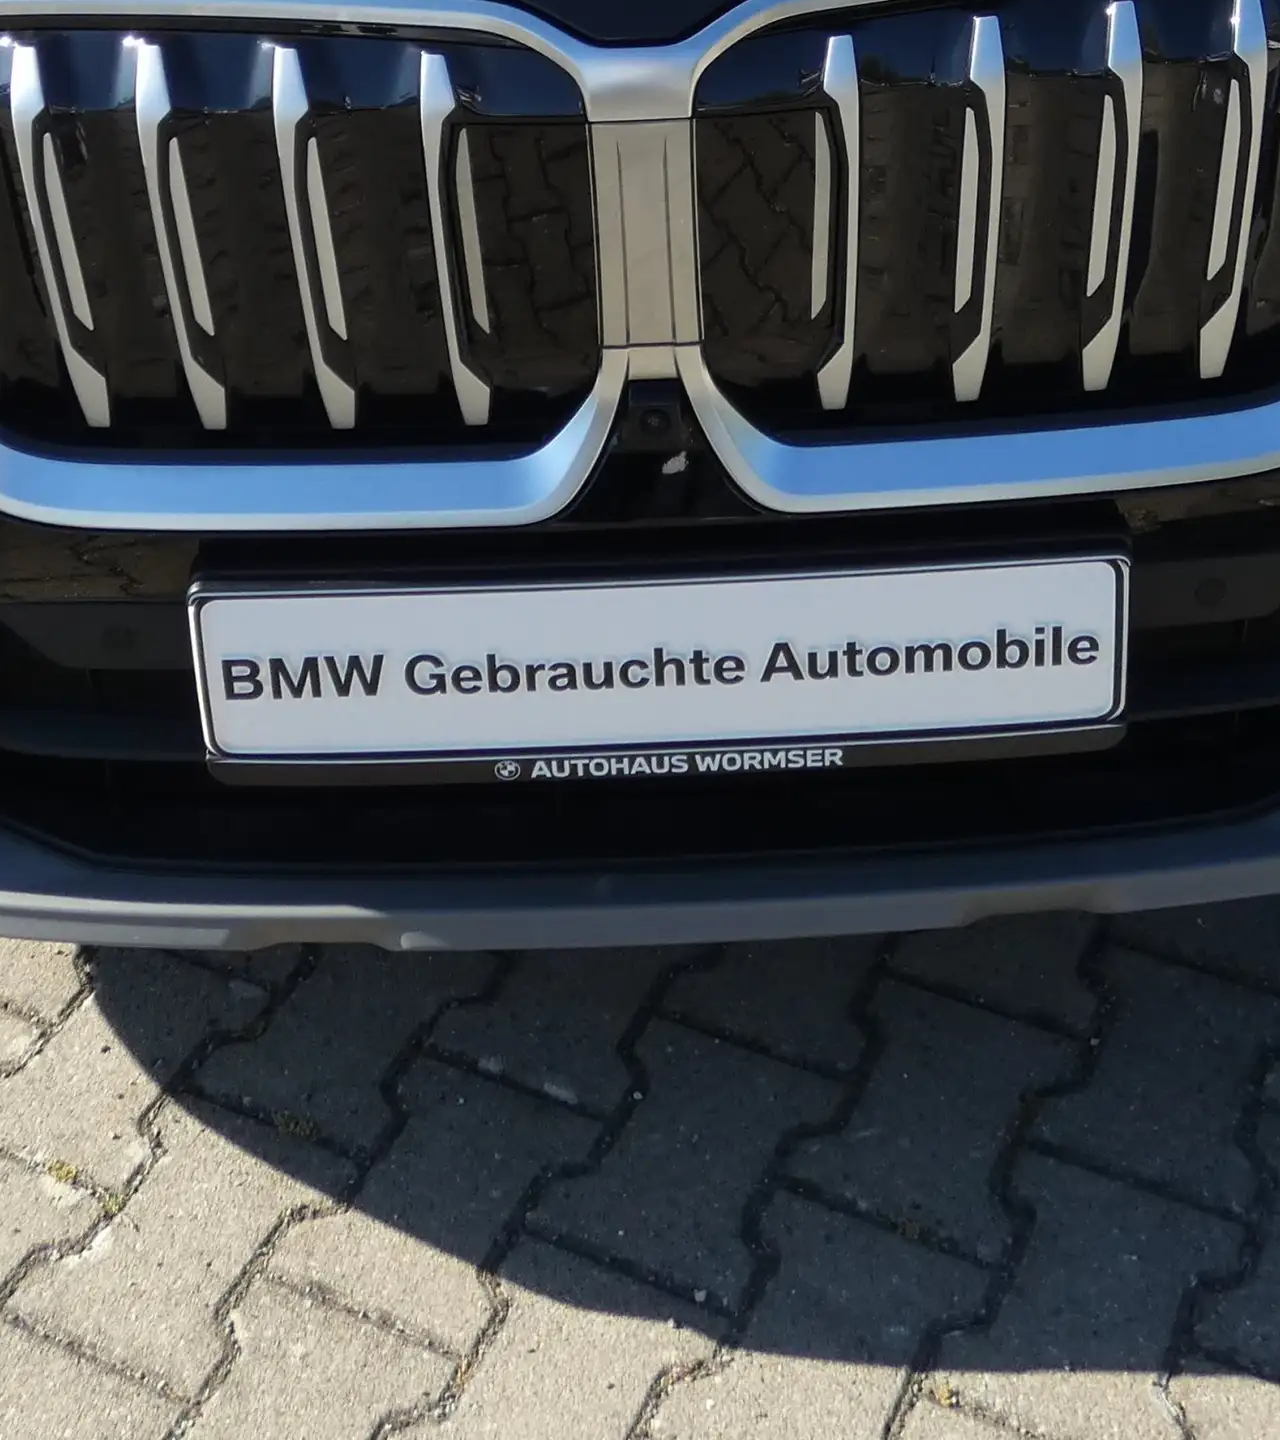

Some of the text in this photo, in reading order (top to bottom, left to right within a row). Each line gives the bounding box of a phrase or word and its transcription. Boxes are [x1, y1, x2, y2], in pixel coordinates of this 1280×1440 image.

[221, 625, 1100, 701] BMW Gebrauchte Automobile
[531, 748, 844, 778] AUTOHAUS WORMSER
